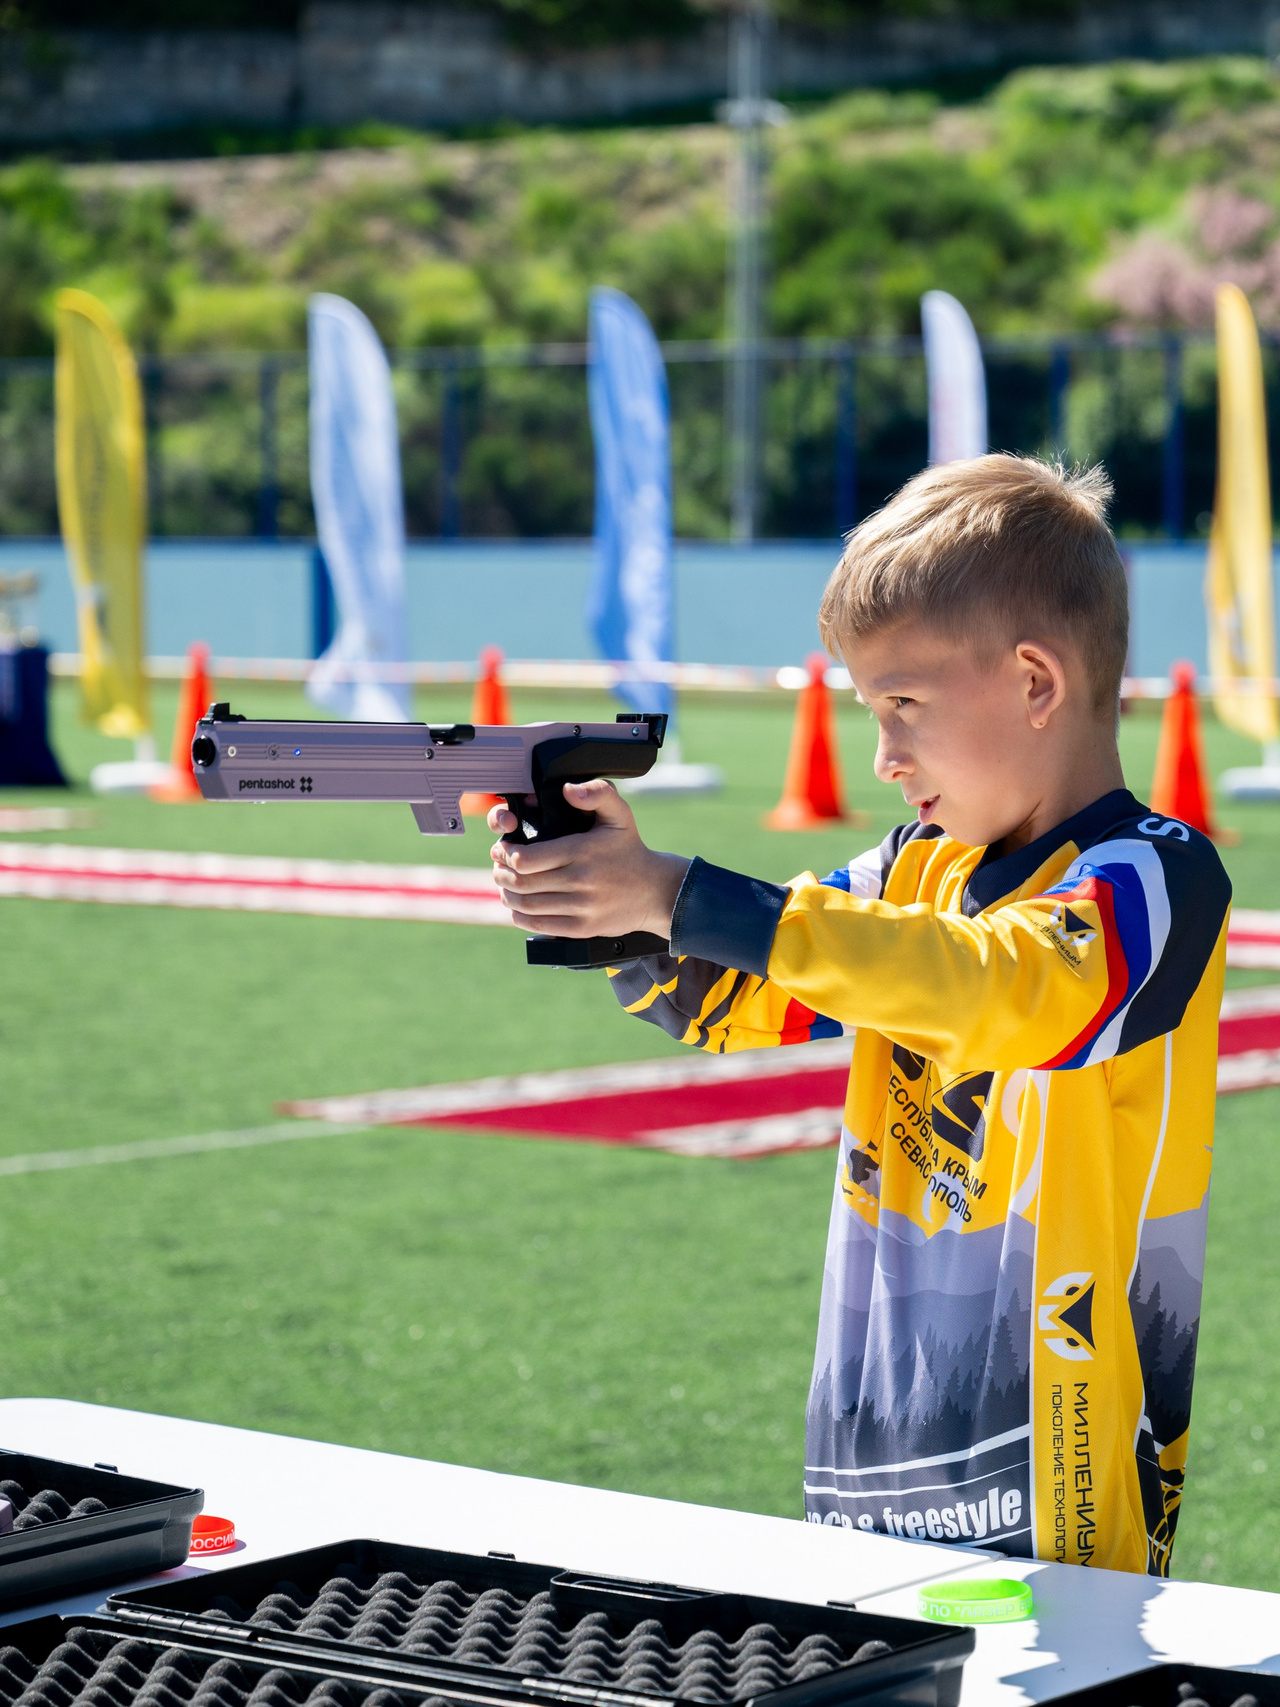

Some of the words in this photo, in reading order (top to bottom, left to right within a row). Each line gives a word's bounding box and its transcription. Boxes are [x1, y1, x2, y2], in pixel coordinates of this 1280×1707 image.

[239, 777, 296, 792] pentashot
[890, 1122, 972, 1223] СЕВАСОПОЛЬ
[942, 1156, 988, 1200] КРЫМ
[1051, 1384, 1065, 1476] ПОКОЛЕНИЕ
[883, 1486, 1022, 1541] freestyle
[930, 1603, 950, 1617] ПО
